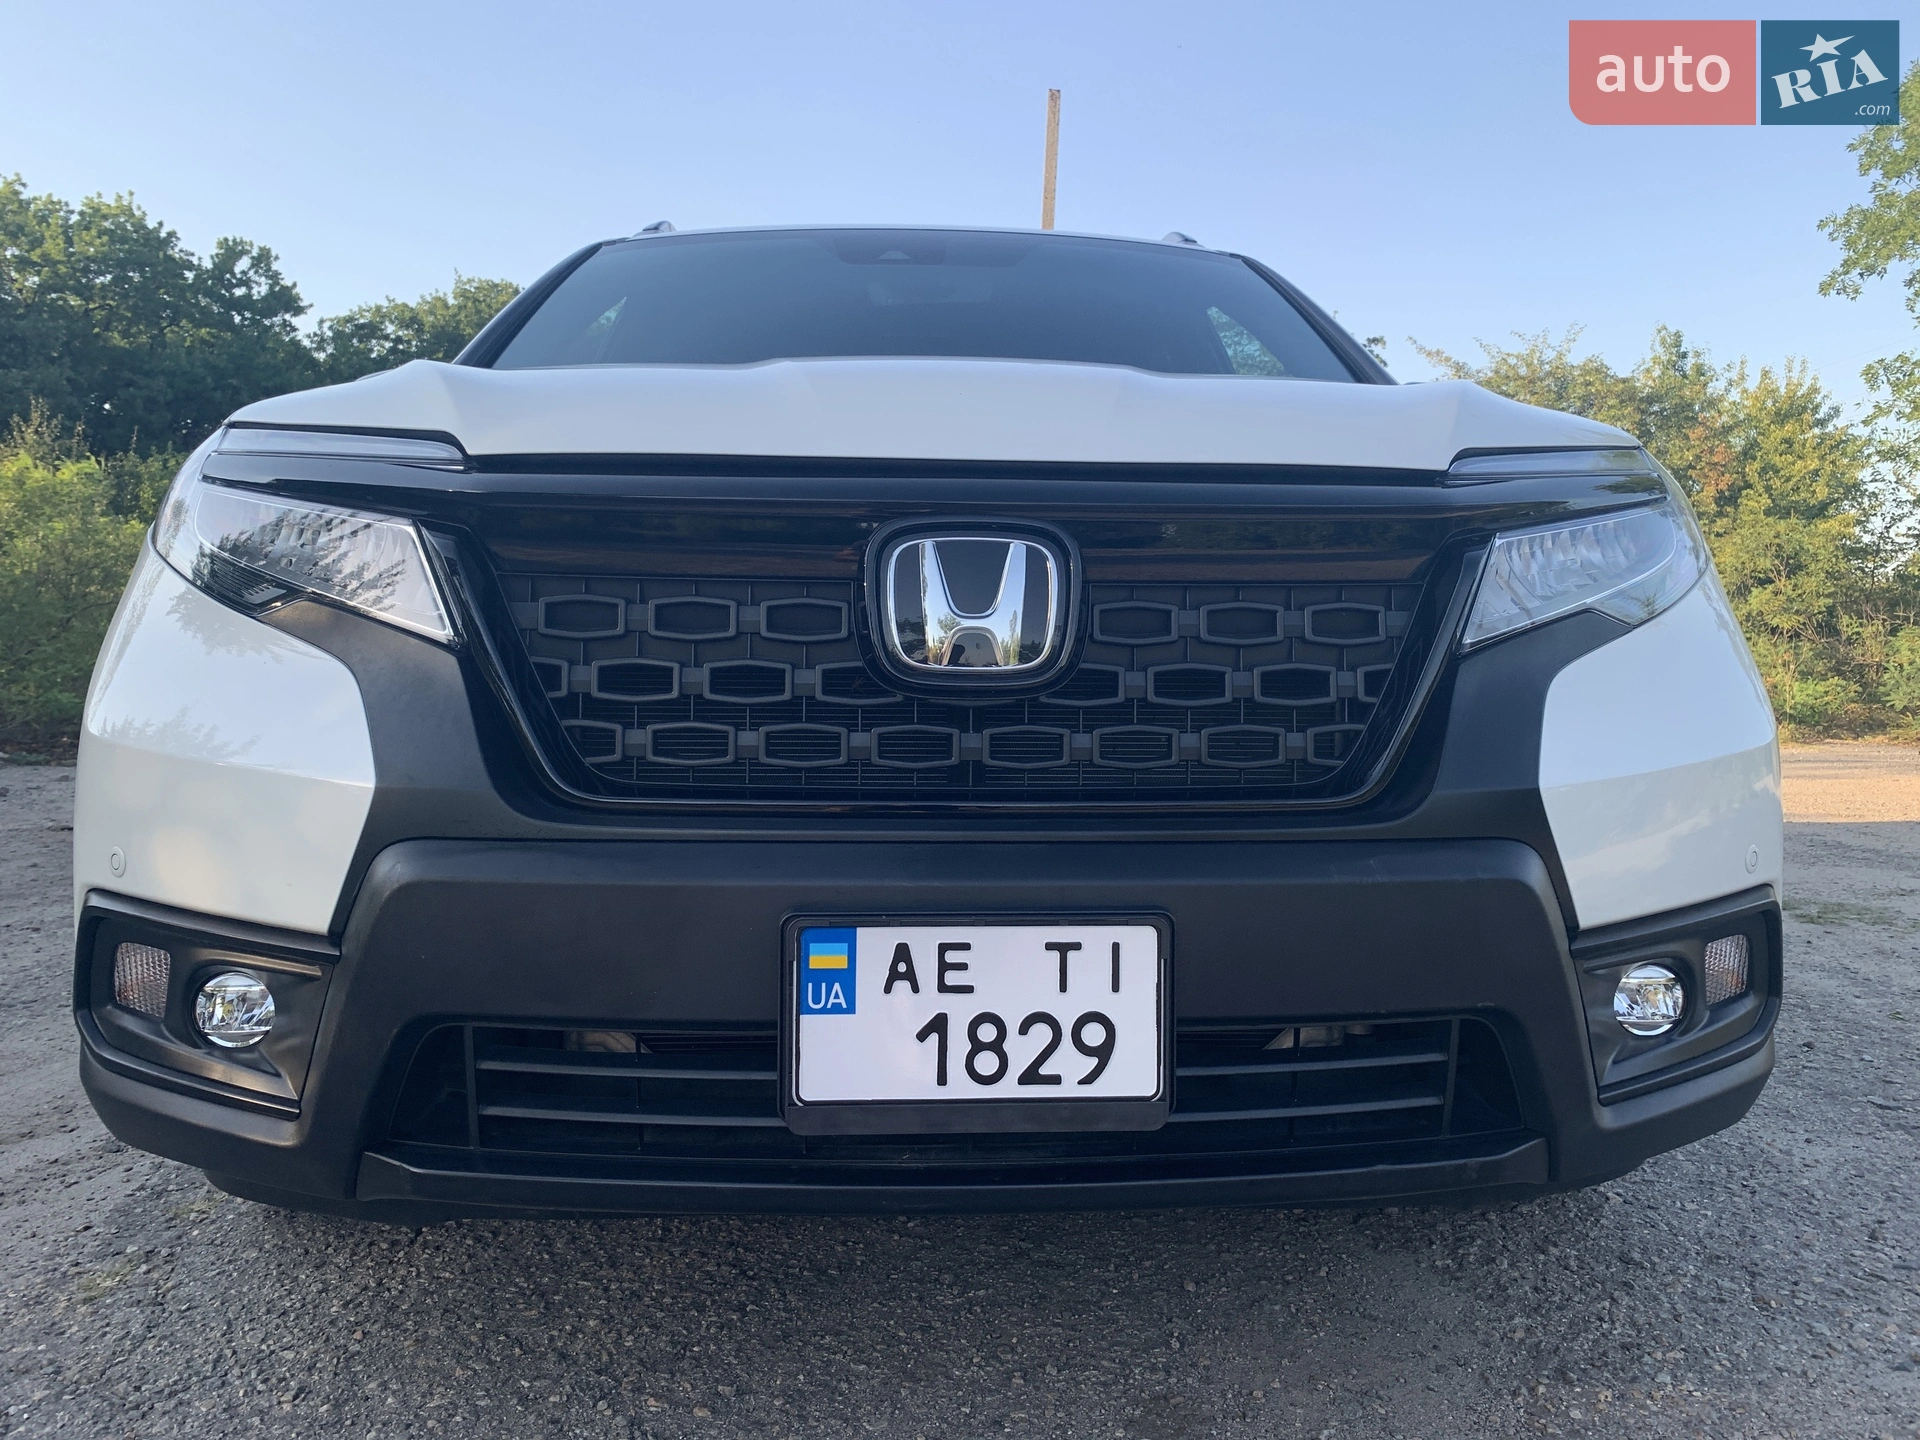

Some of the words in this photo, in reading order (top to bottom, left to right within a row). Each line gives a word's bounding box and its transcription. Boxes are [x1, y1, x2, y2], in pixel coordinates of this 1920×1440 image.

[883, 941, 975, 994] AE
[1044, 941, 1120, 994] TI
[807, 983, 847, 1010] UA
[915, 1010, 1116, 1086] 1829
